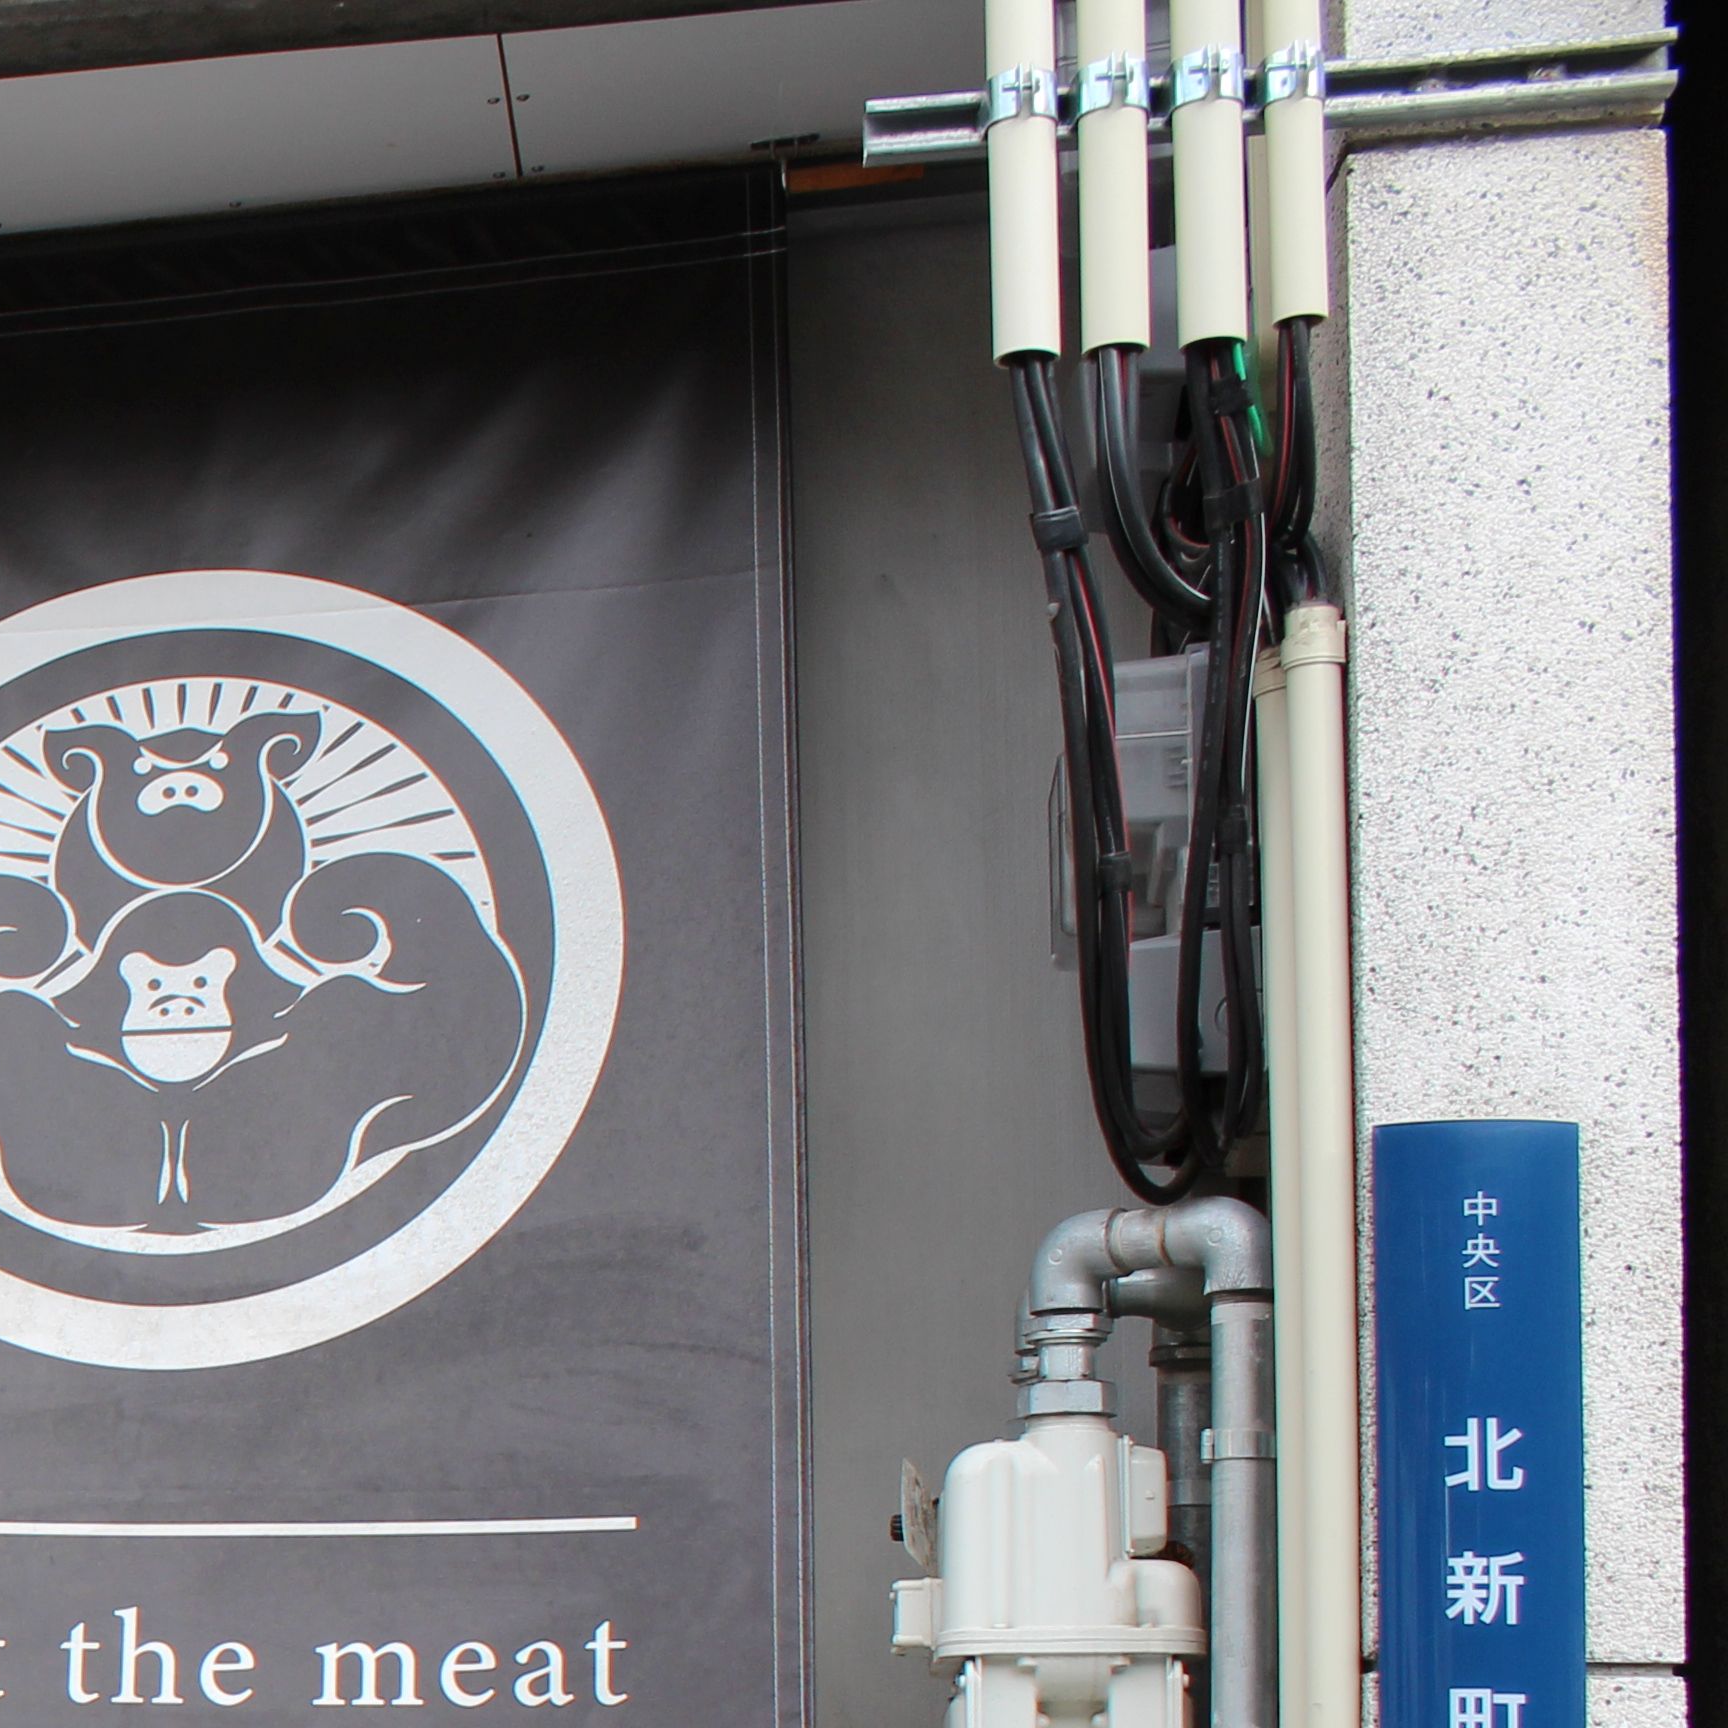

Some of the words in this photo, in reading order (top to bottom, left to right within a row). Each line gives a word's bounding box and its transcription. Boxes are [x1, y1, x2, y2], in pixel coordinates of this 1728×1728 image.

[1462, 1190, 1501, 1310] 中央区
[59, 1606, 257, 1708] the
[310, 1620, 630, 1709] meat
